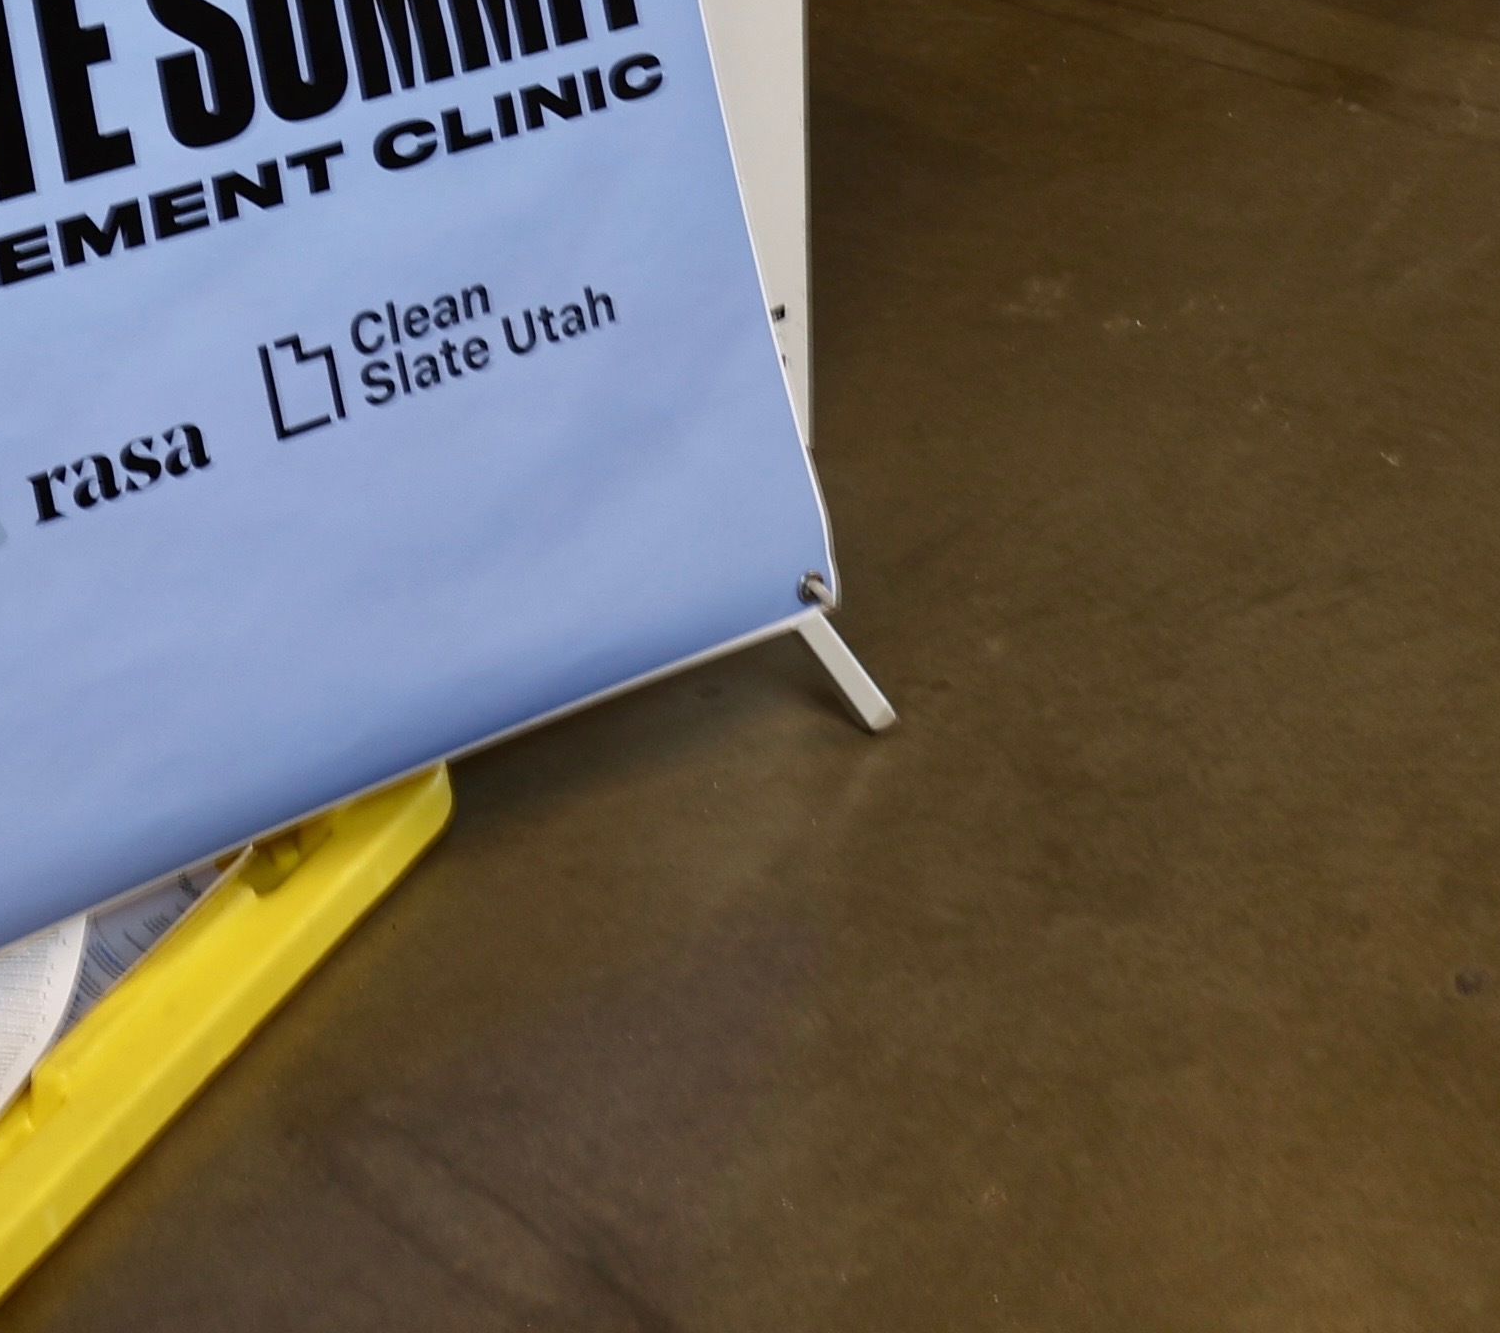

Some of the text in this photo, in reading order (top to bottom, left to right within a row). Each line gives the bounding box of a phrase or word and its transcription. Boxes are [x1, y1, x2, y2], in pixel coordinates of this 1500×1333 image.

[373, 50, 668, 177] CLINIC
[349, 280, 493, 358] Clean
[360, 285, 618, 408] Slate Utah
[26, 420, 212, 525] rasa
